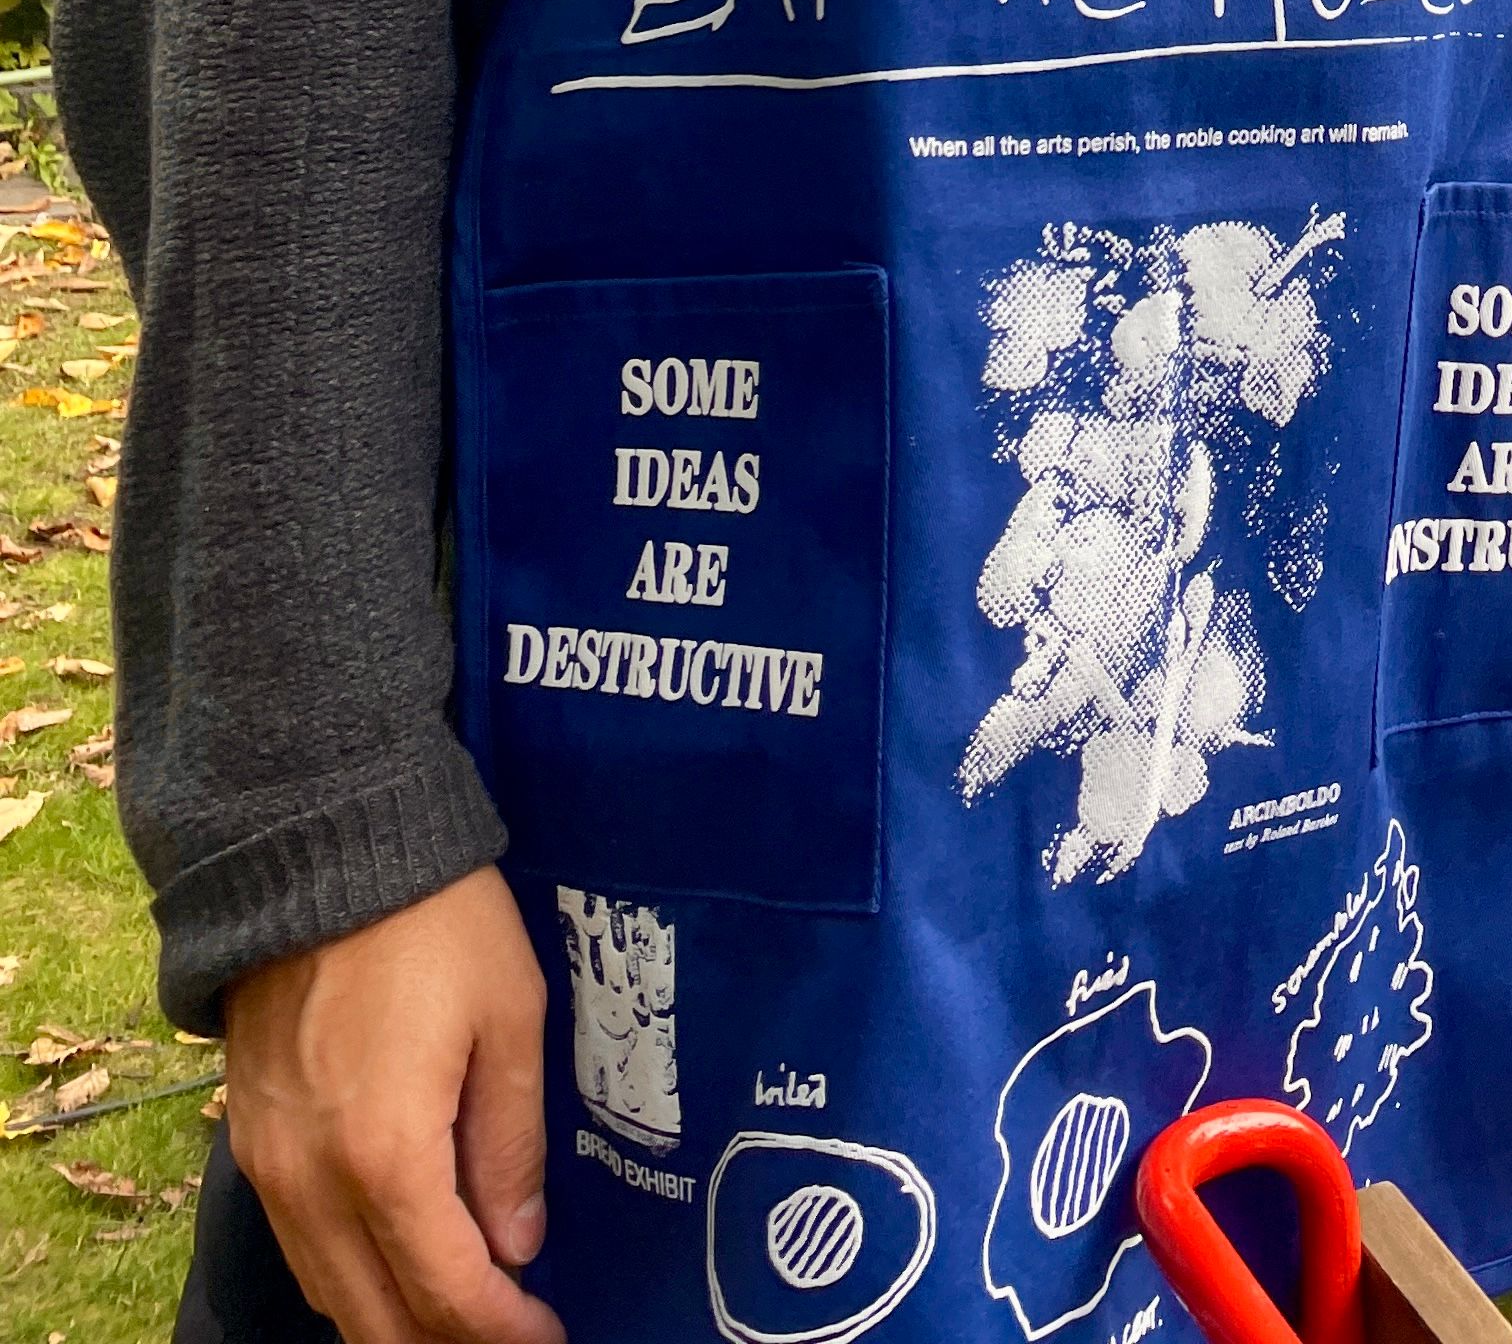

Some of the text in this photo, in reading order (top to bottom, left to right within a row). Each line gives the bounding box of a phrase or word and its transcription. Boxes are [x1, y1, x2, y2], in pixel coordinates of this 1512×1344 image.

[909, 136, 967, 157] When
[972, 136, 995, 157] all
[999, 135, 1032, 155] the
[1036, 134, 1073, 155] arts
[1077, 132, 1141, 157] perish,
[1144, 130, 1171, 151] the
[1176, 127, 1224, 148] noble
[1228, 124, 1296, 147] cooking
[1301, 124, 1326, 144] art
[1329, 123, 1358, 144] will
[620, 357, 760, 419] SOME
[613, 448, 760, 514] IDEAS
[626, 540, 729, 606] ARE
[503, 623, 823, 717] DESTRUCTIVE
[1228, 782, 1342, 831] ARCIMBOLDO
[624, 1158, 697, 1204] EXHIBIT
